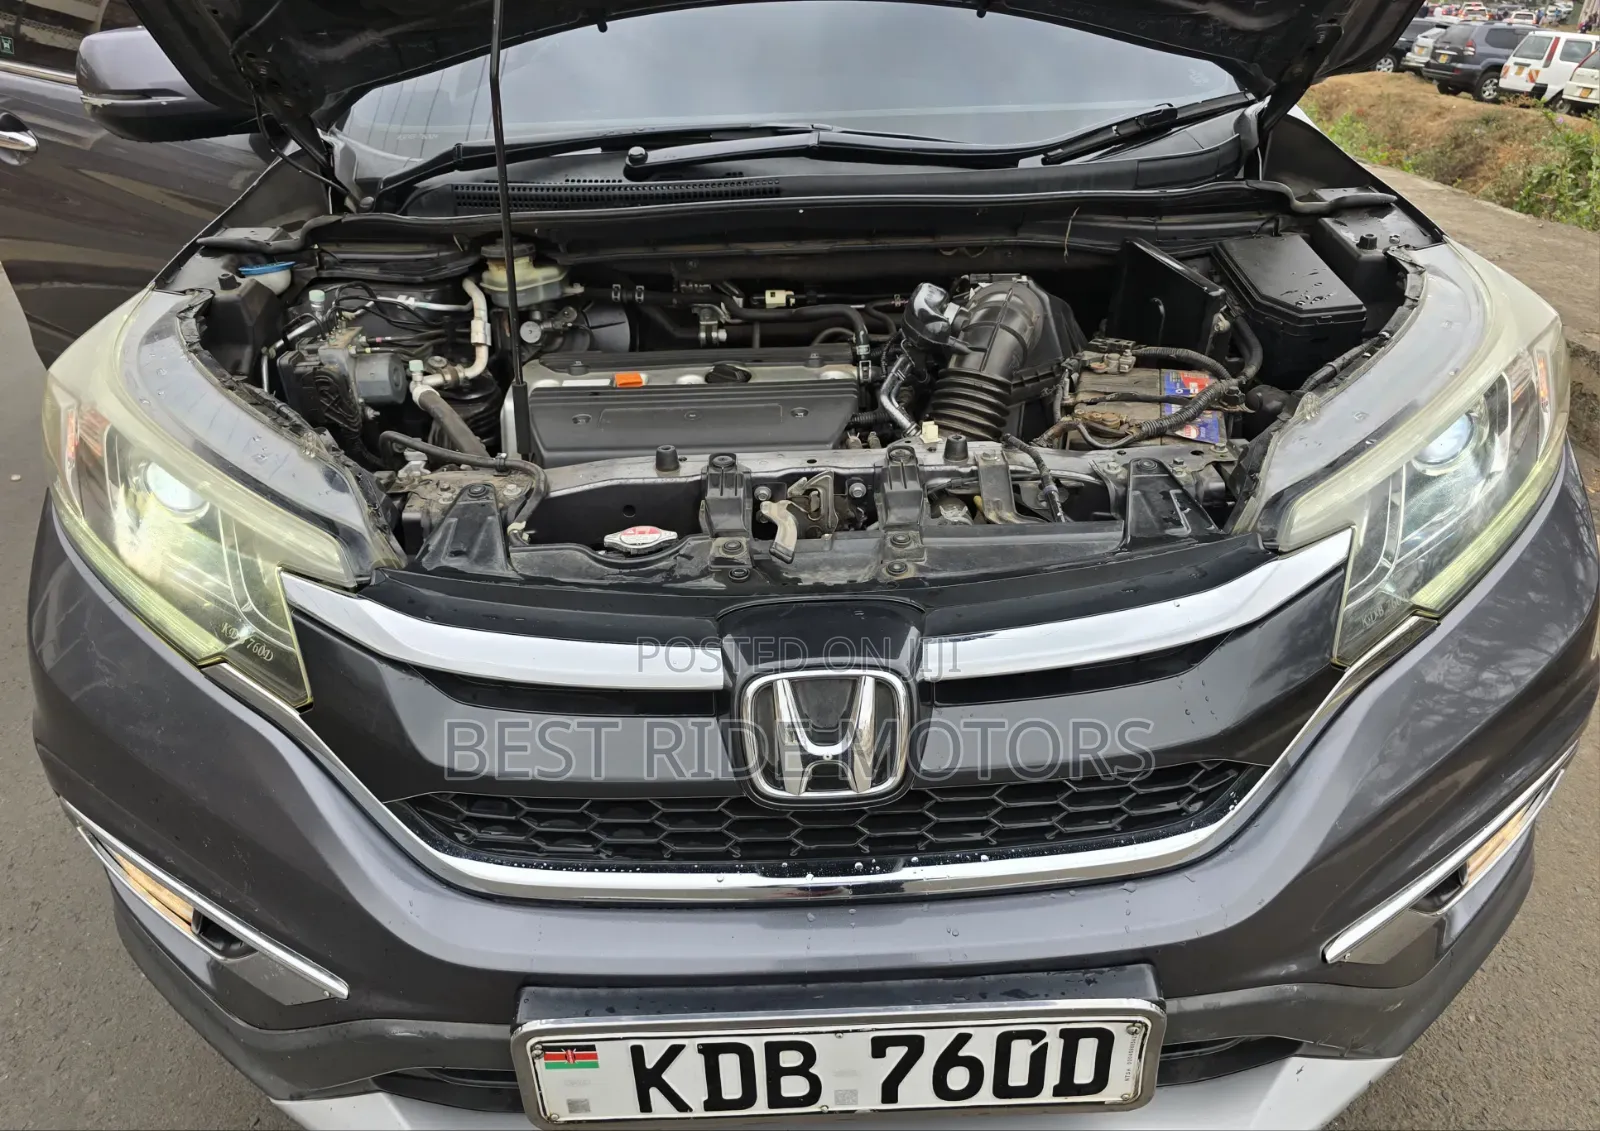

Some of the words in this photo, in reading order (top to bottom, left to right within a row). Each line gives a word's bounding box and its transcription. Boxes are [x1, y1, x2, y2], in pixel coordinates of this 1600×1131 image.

[220, 622, 245, 643] KD
[247, 638, 274, 661] 760D
[630, 1040, 822, 1113] KDB
[870, 1027, 1115, 1104] 760D
